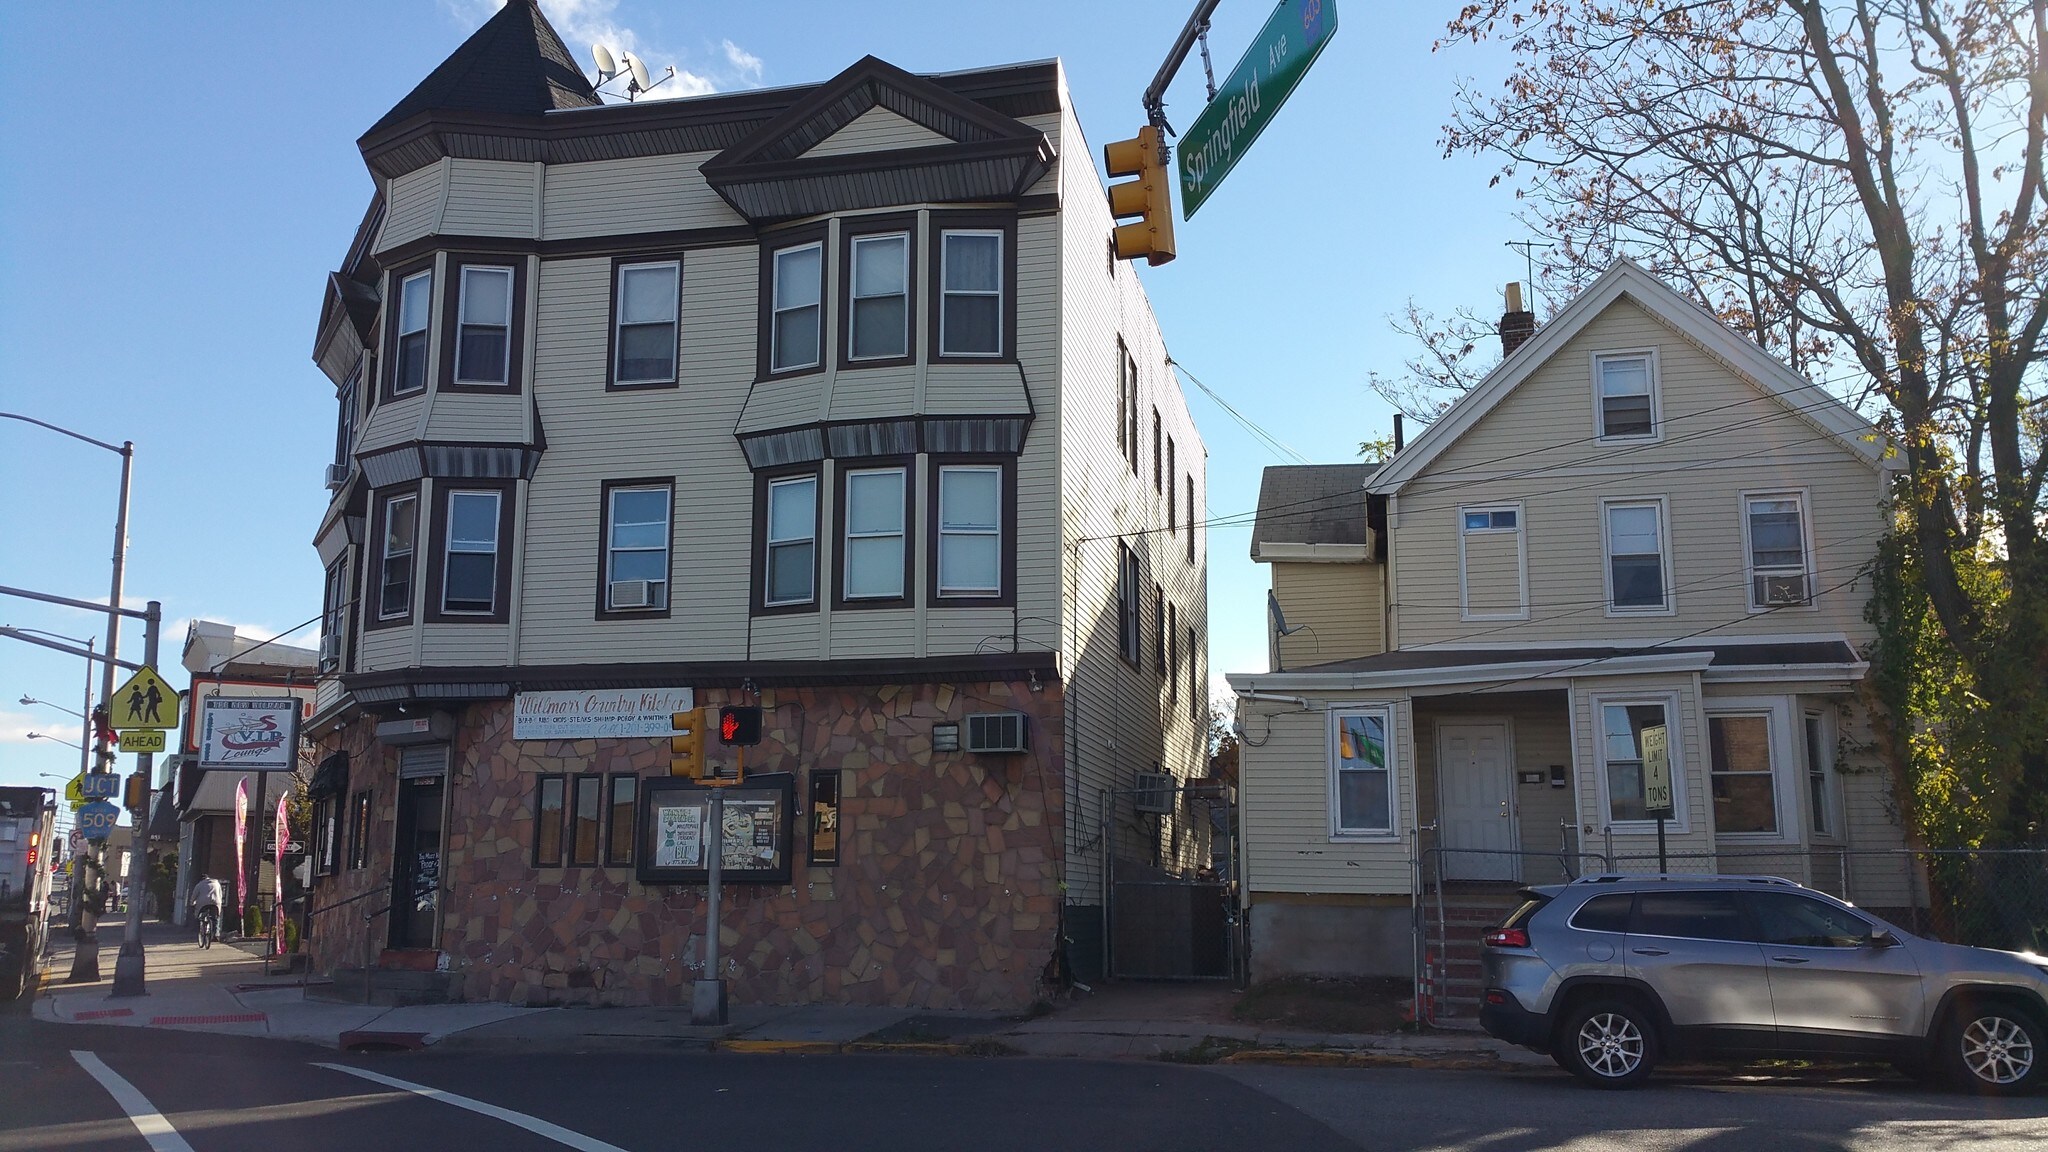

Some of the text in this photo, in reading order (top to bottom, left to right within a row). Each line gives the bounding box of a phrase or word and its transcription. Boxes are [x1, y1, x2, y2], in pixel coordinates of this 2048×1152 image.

[1186, 33, 1287, 194] Springfield Ave
[584, 694, 637, 715] Country
[123, 736, 162, 747] AHEAD
[1645, 732, 1665, 748] WEIGHT
[221, 746, 273, 761] Lounge
[1647, 749, 1663, 763] LIMIT
[1653, 765, 1659, 780] 4
[84, 777, 118, 794] JCT
[1648, 786, 1667, 802] TONS
[83, 813, 117, 828] 509
